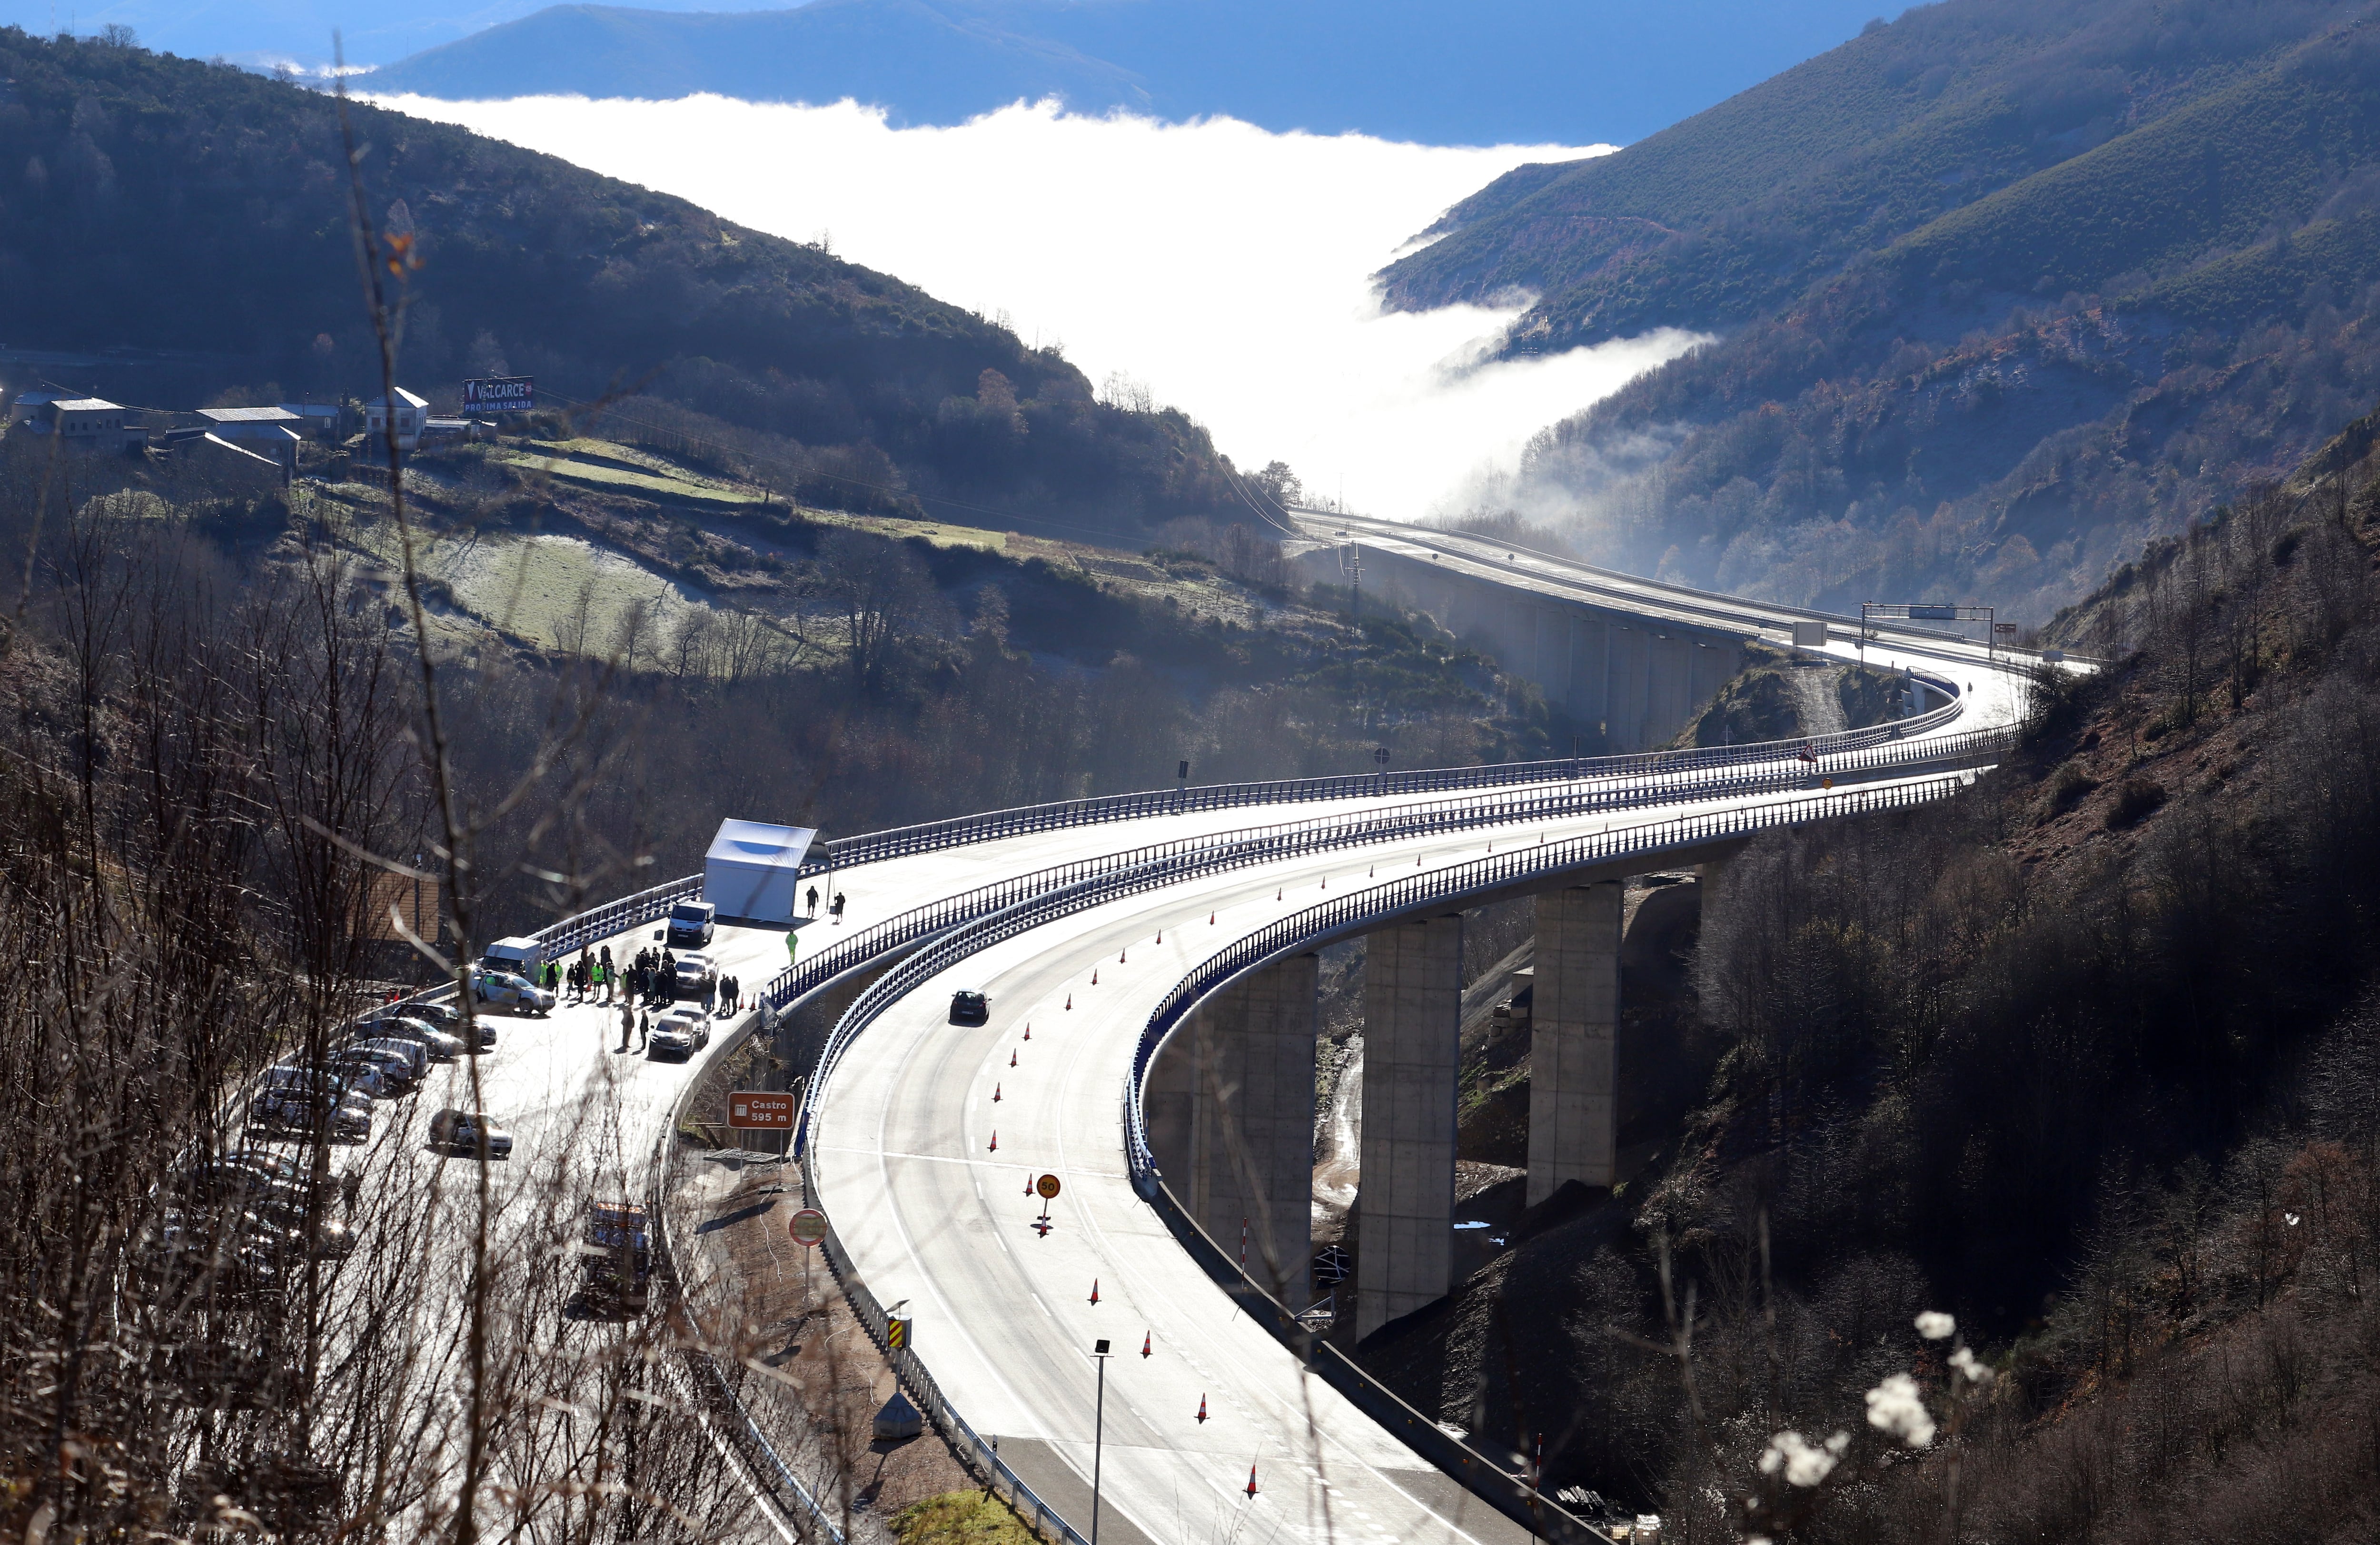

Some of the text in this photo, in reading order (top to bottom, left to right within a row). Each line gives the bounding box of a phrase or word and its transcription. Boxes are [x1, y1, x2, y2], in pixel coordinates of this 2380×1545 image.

[465, 401, 532, 411] PROIMA SALIDA
[752, 1100, 786, 1109] Castro
[752, 1113, 772, 1121] 595
[1041, 1182, 1054, 1191] 50
